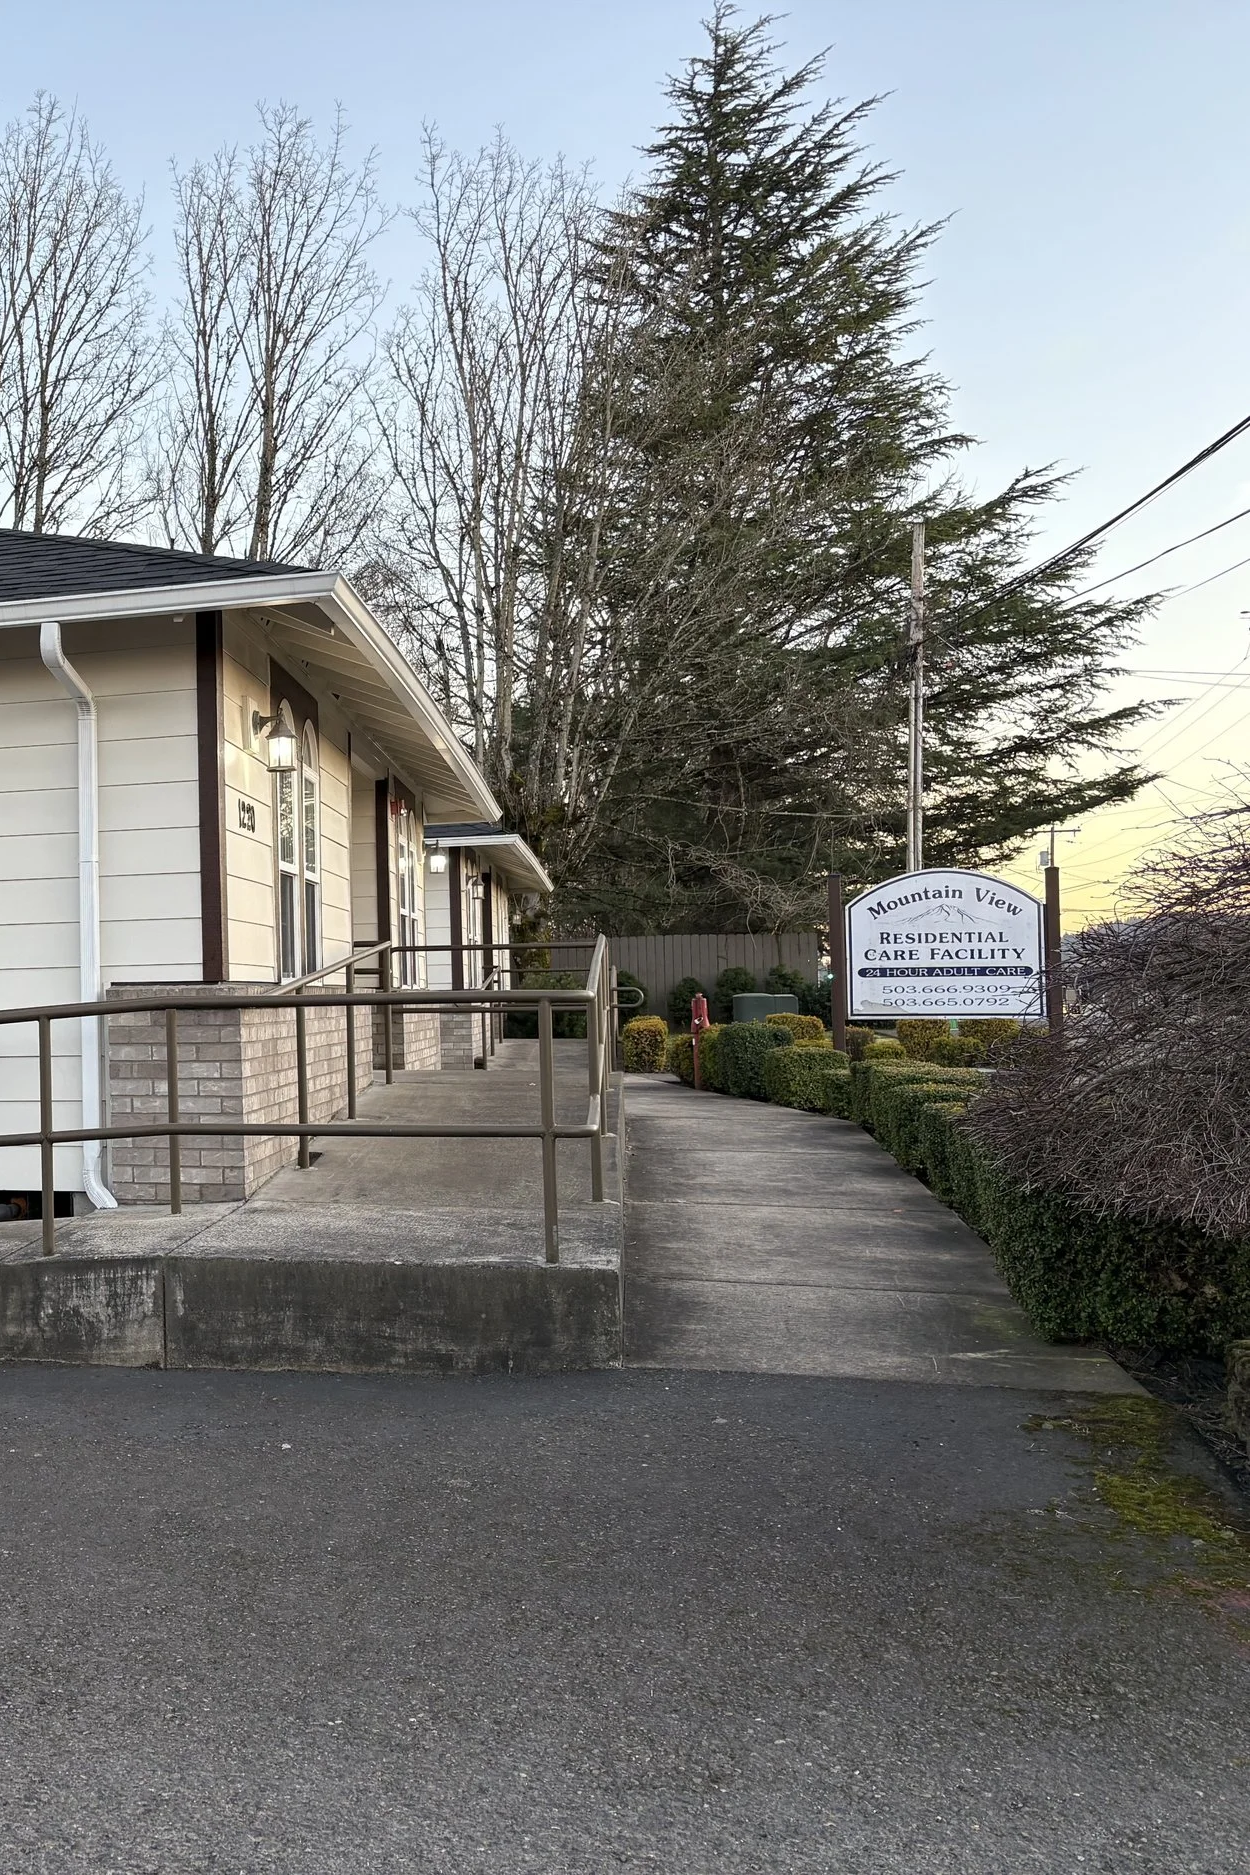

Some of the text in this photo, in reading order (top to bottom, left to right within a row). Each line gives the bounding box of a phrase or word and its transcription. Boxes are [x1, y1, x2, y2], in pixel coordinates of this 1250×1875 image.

[866, 885, 1023, 920] Mountain View
[879, 931, 1009, 945] RESIDENTIAL
[864, 948, 1026, 961] CARE FACILITY
[865, 966, 1027, 977] 24 HOUR ADULT CARE
[882, 985, 1011, 994] 503.666.9309
[882, 997, 1010, 1007] 503.665.0792
